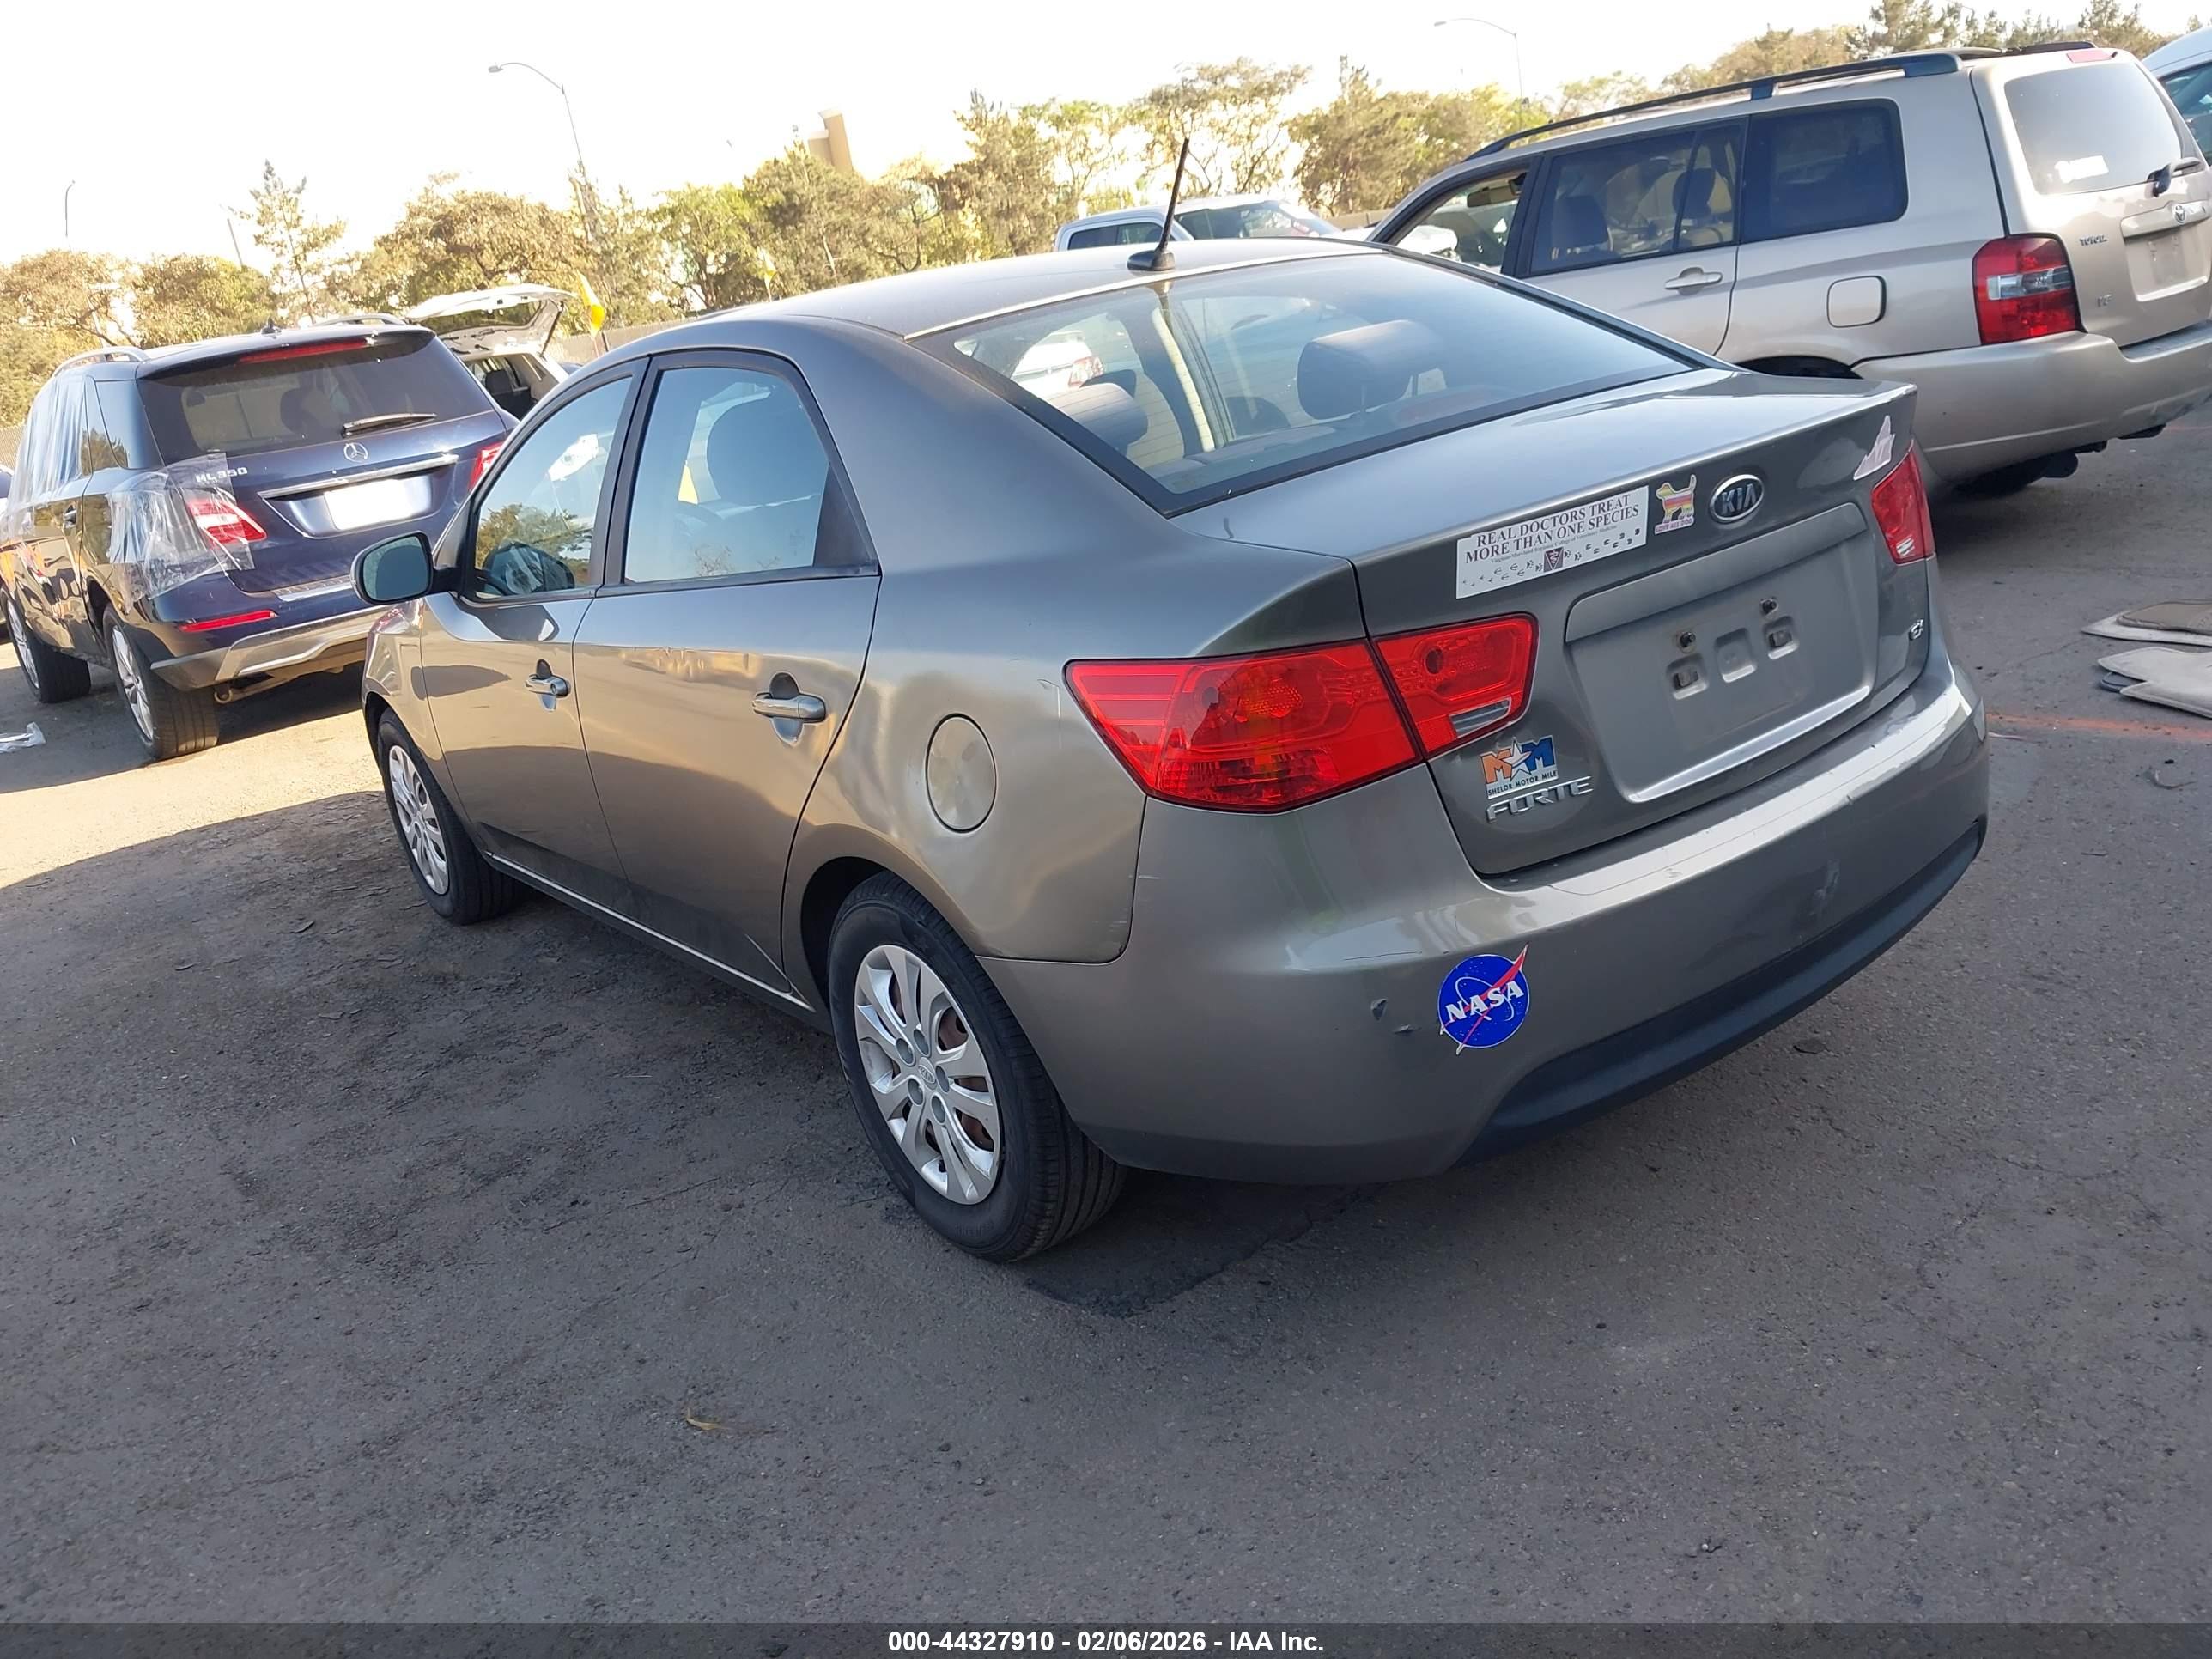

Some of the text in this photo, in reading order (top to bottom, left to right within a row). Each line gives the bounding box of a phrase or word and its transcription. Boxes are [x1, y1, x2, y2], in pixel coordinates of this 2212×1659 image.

[217, 467, 248, 478] 350
[1722, 483, 1757, 515] KIA
[1466, 504, 1639, 564] MORE THAN ONE SPECIES
[1477, 494, 1631, 547] REAL DOCTORS TREAT
[1486, 775, 1594, 822] FORTE
[1488, 770, 1557, 796] SHELOR MOTOR MILE
[1445, 981, 1525, 1023] NASA
